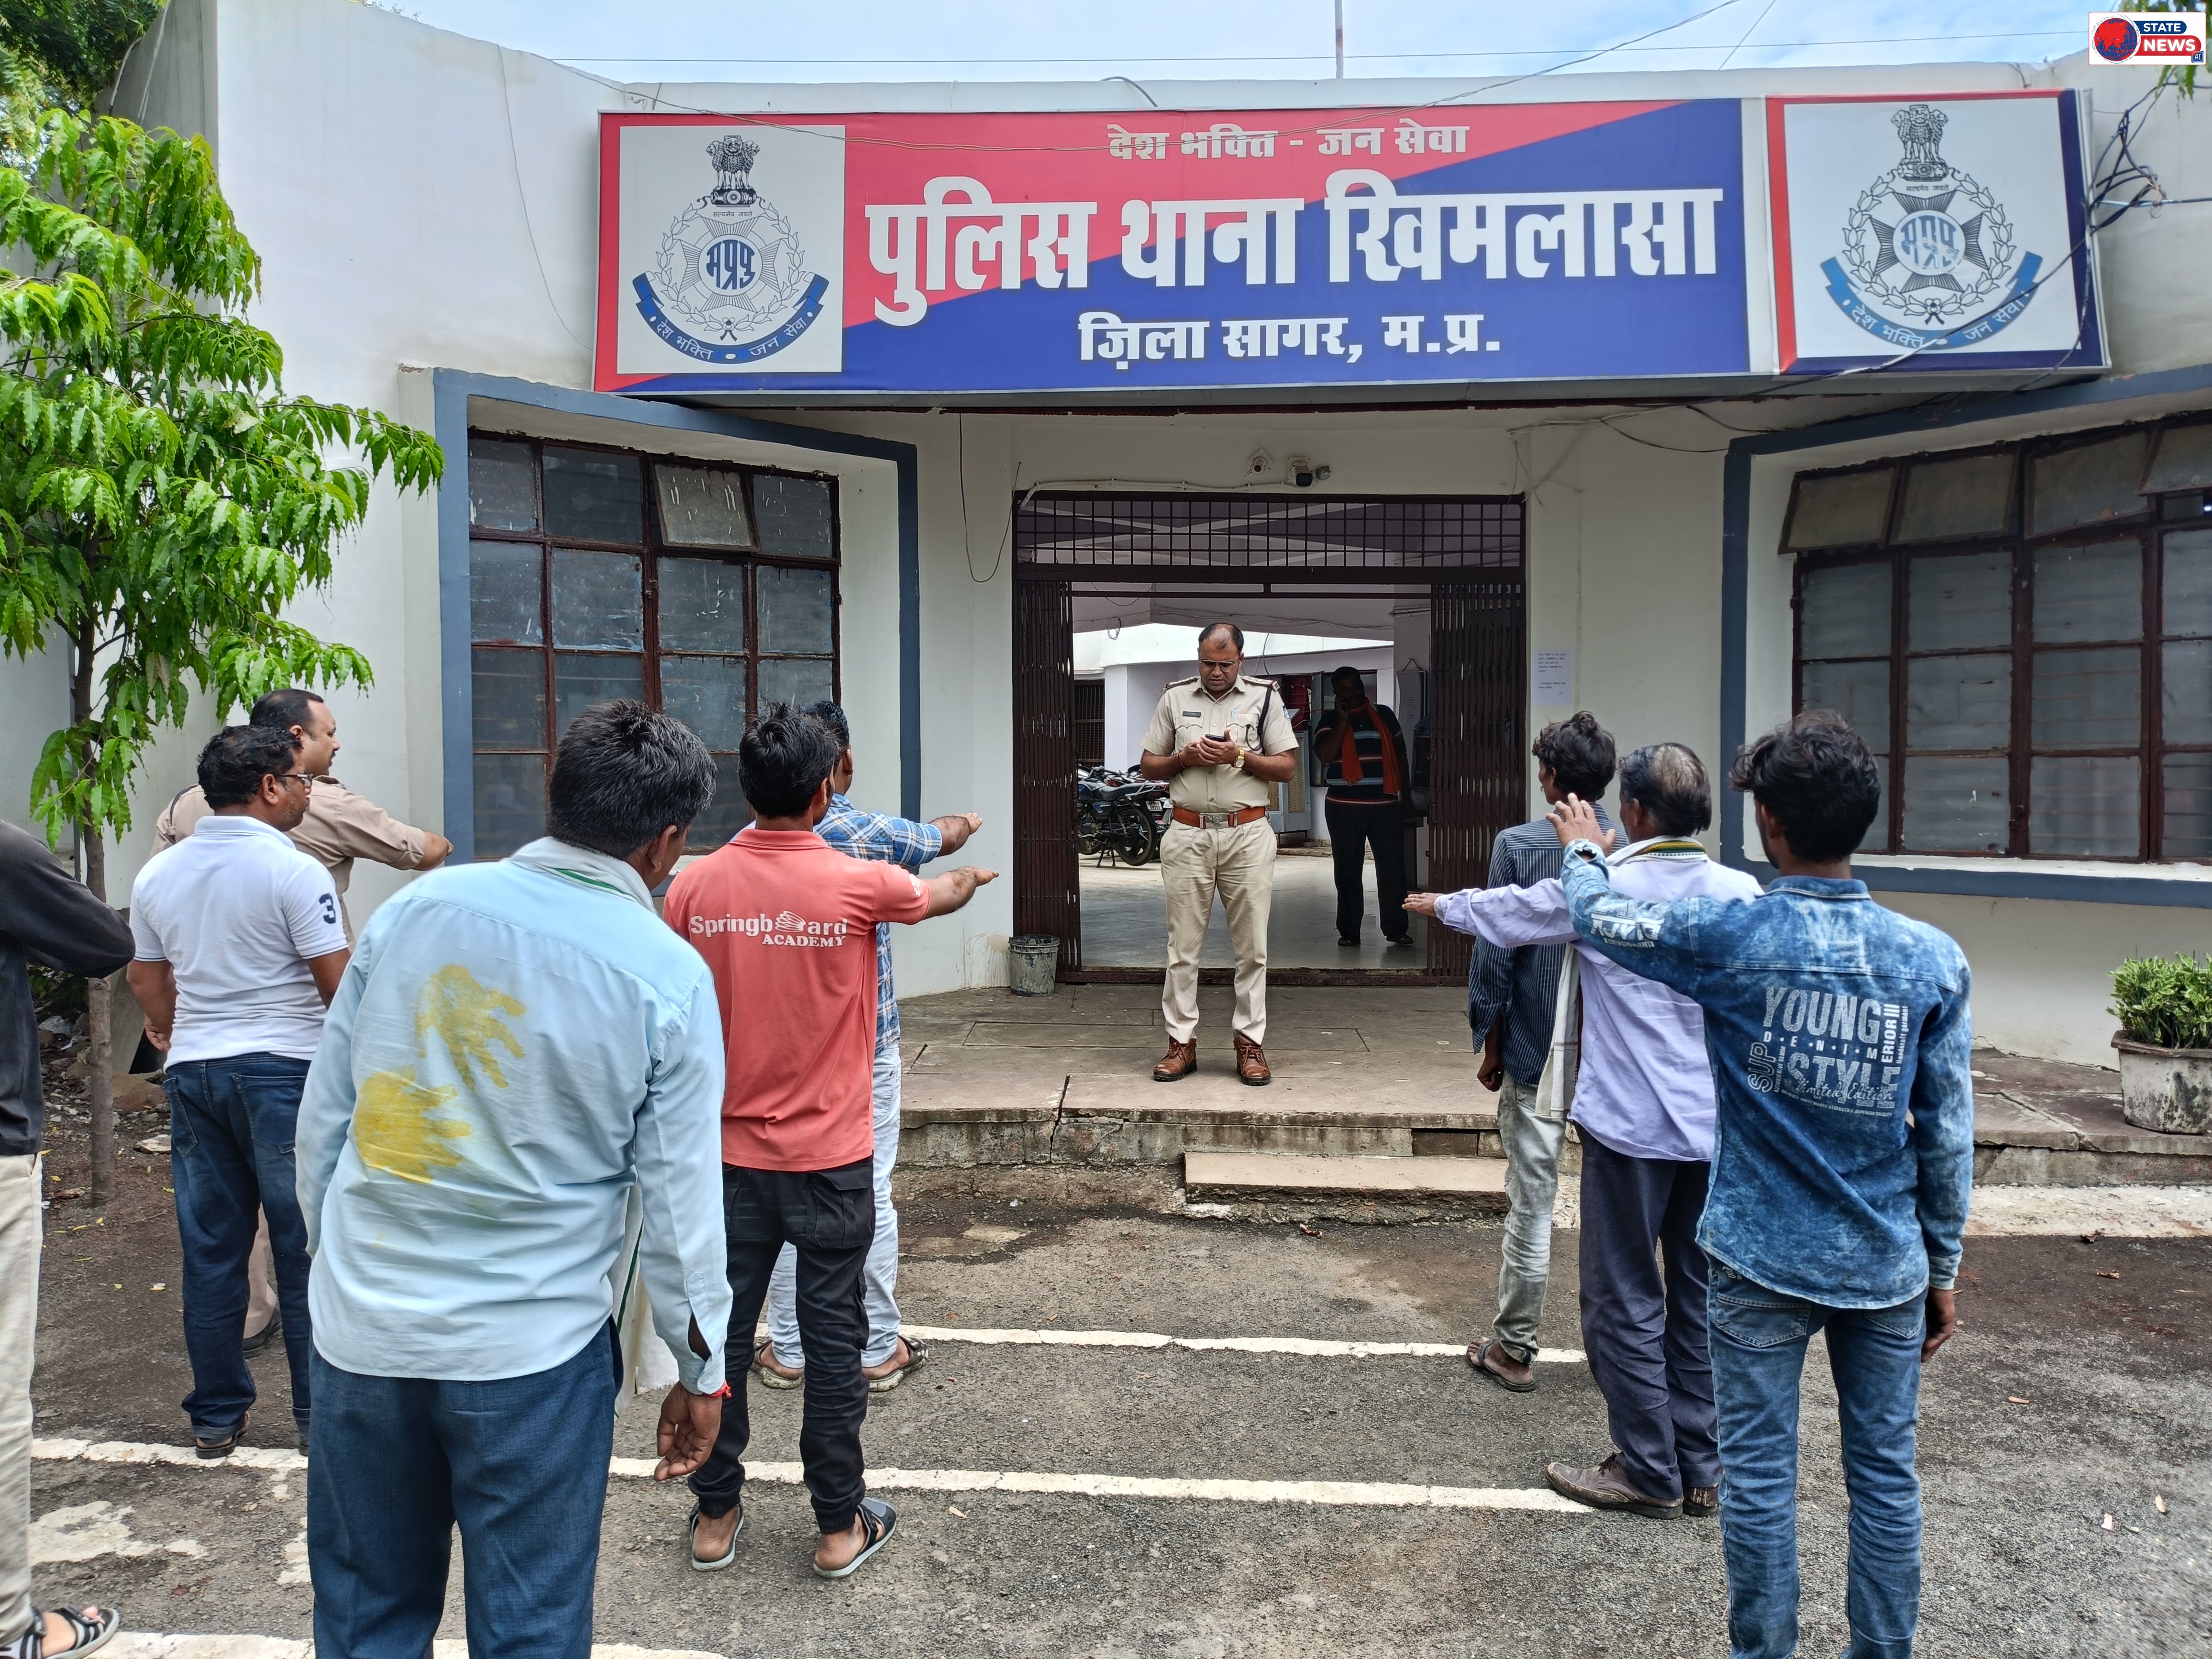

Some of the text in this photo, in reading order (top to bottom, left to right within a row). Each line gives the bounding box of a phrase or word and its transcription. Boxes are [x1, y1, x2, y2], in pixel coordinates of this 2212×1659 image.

[1107, 124, 1170, 160] देश
[1181, 124, 1279, 159] भक्ति
[1317, 127, 1385, 155] जन
[1394, 118, 1470, 154] सेवा
[864, 168, 1723, 326] पुलिस थाना खिमलासा
[656, 317, 807, 360] देश भक्ति जन सेवा
[1221, 317, 1363, 364] सागर,
[1382, 314, 1501, 355] म.प्र.
[1851, 299, 2025, 349] देश भक्ति जन सेवा
[319, 893, 336, 924] 3
[690, 910, 848, 938] Springbard
[762, 935, 846, 948] ACADEMY
[1763, 986, 1881, 1044] YOUNG
[1787, 1052, 1901, 1109] STYLE
